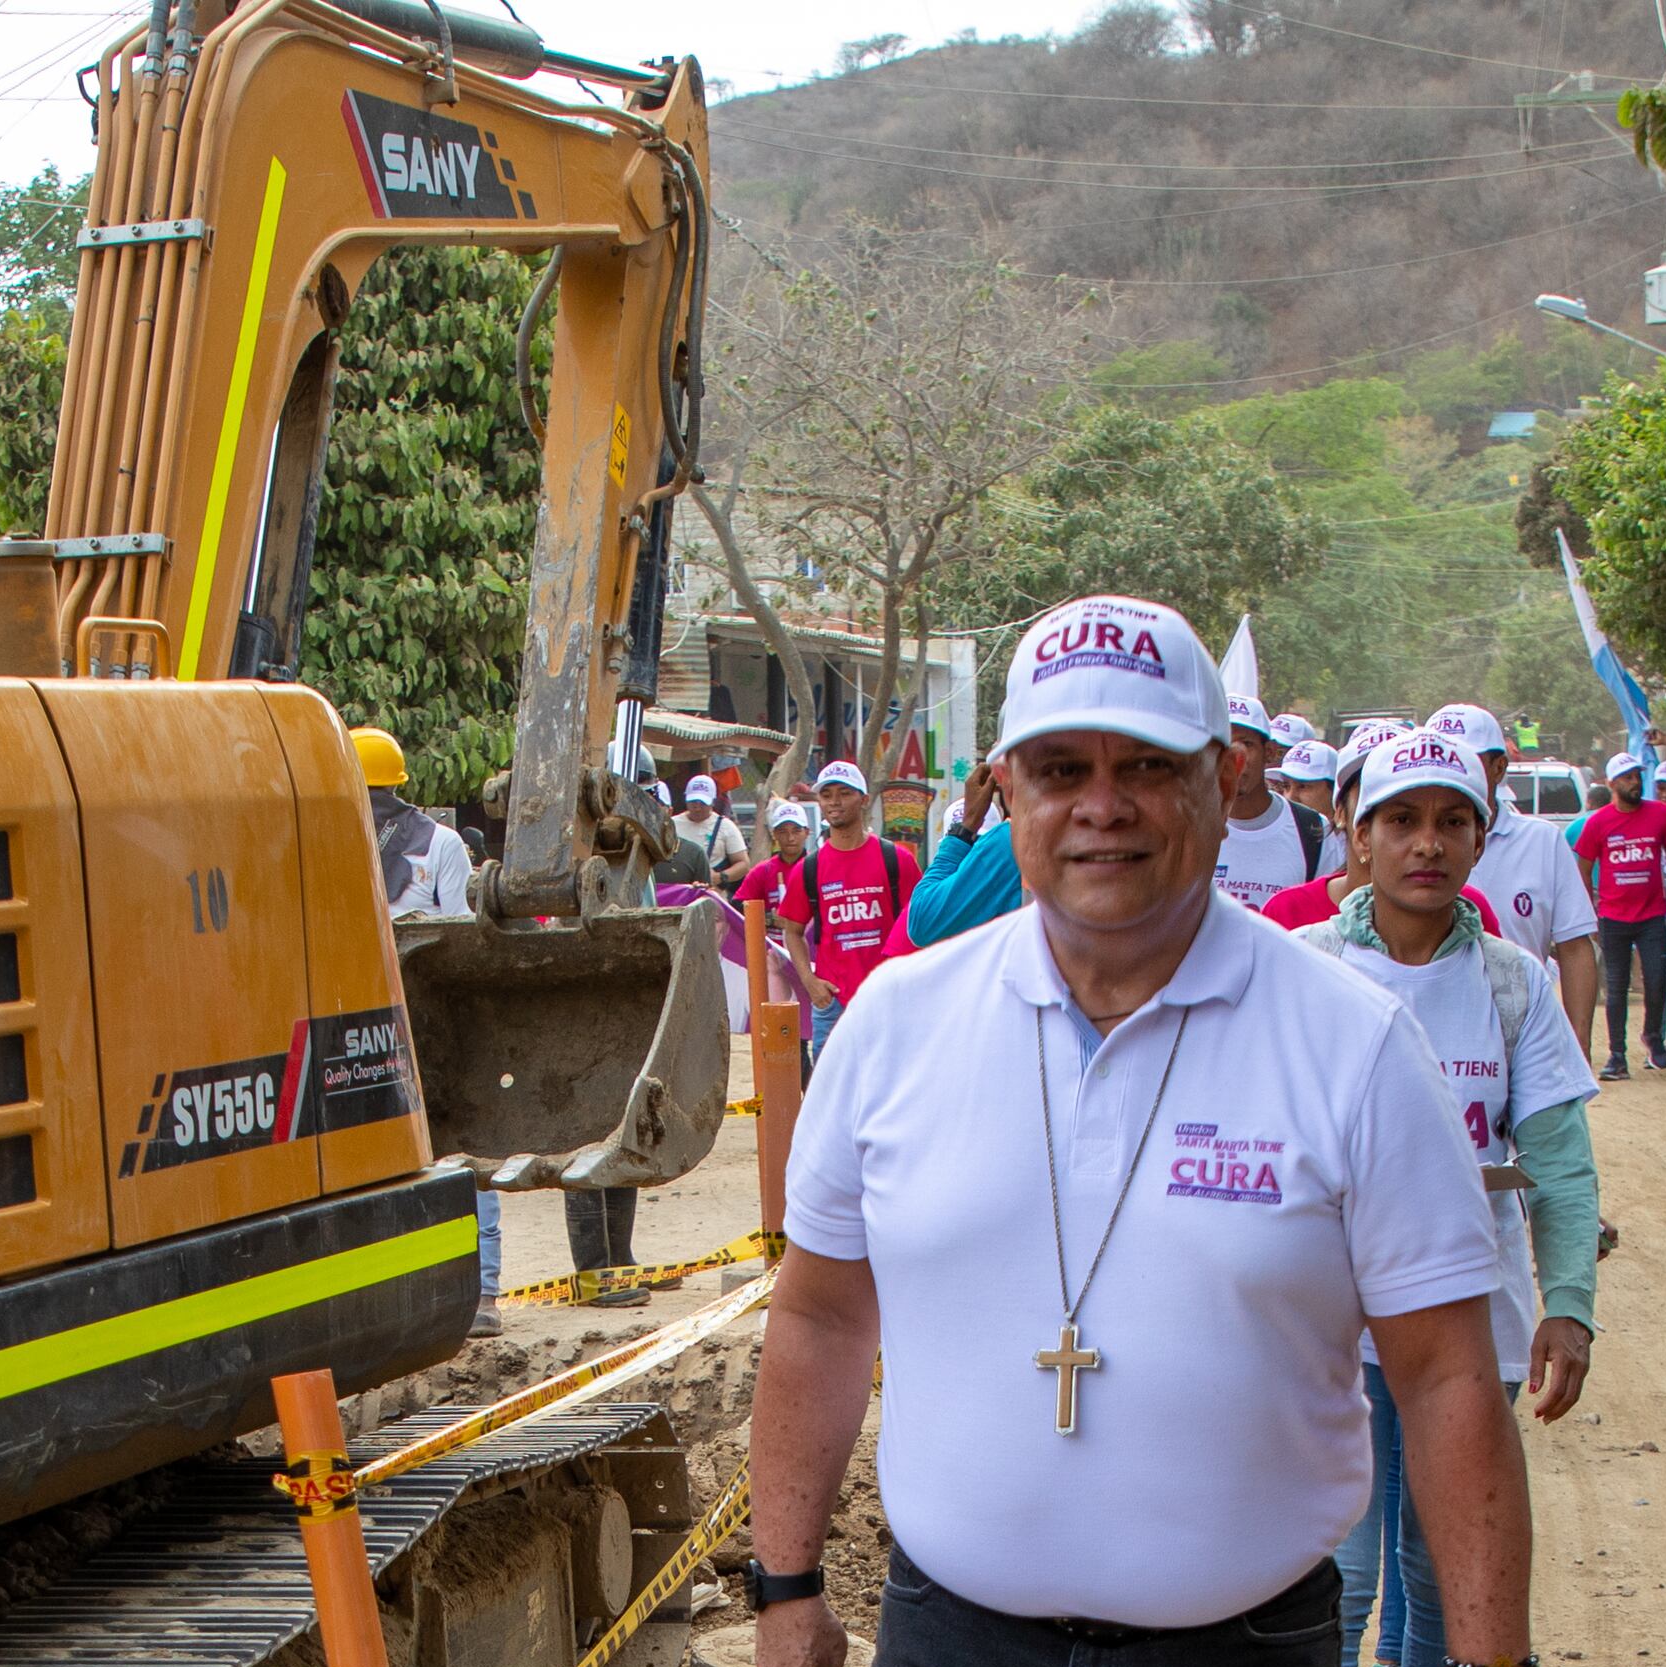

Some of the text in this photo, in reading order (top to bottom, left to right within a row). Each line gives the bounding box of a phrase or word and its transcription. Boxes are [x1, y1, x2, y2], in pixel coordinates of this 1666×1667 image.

[381, 131, 480, 199] SANY
[1035, 621, 1163, 664] CURA
[1357, 732, 1397, 749] CUR
[1393, 743, 1464, 768] CURA
[1609, 847, 1654, 864] CURA
[186, 867, 229, 934] 10
[828, 899, 883, 925] CURA
[345, 1022, 397, 1058] SANY
[325, 1064, 352, 1086] Quality
[353, 1061, 386, 1081] Changes
[1452, 1061, 1499, 1078] TIENE
[172, 1072, 275, 1148] SY55C
[1175, 1136, 1285, 1154] SANTA MARTA TIENE
[1170, 1157, 1281, 1193] CURA
